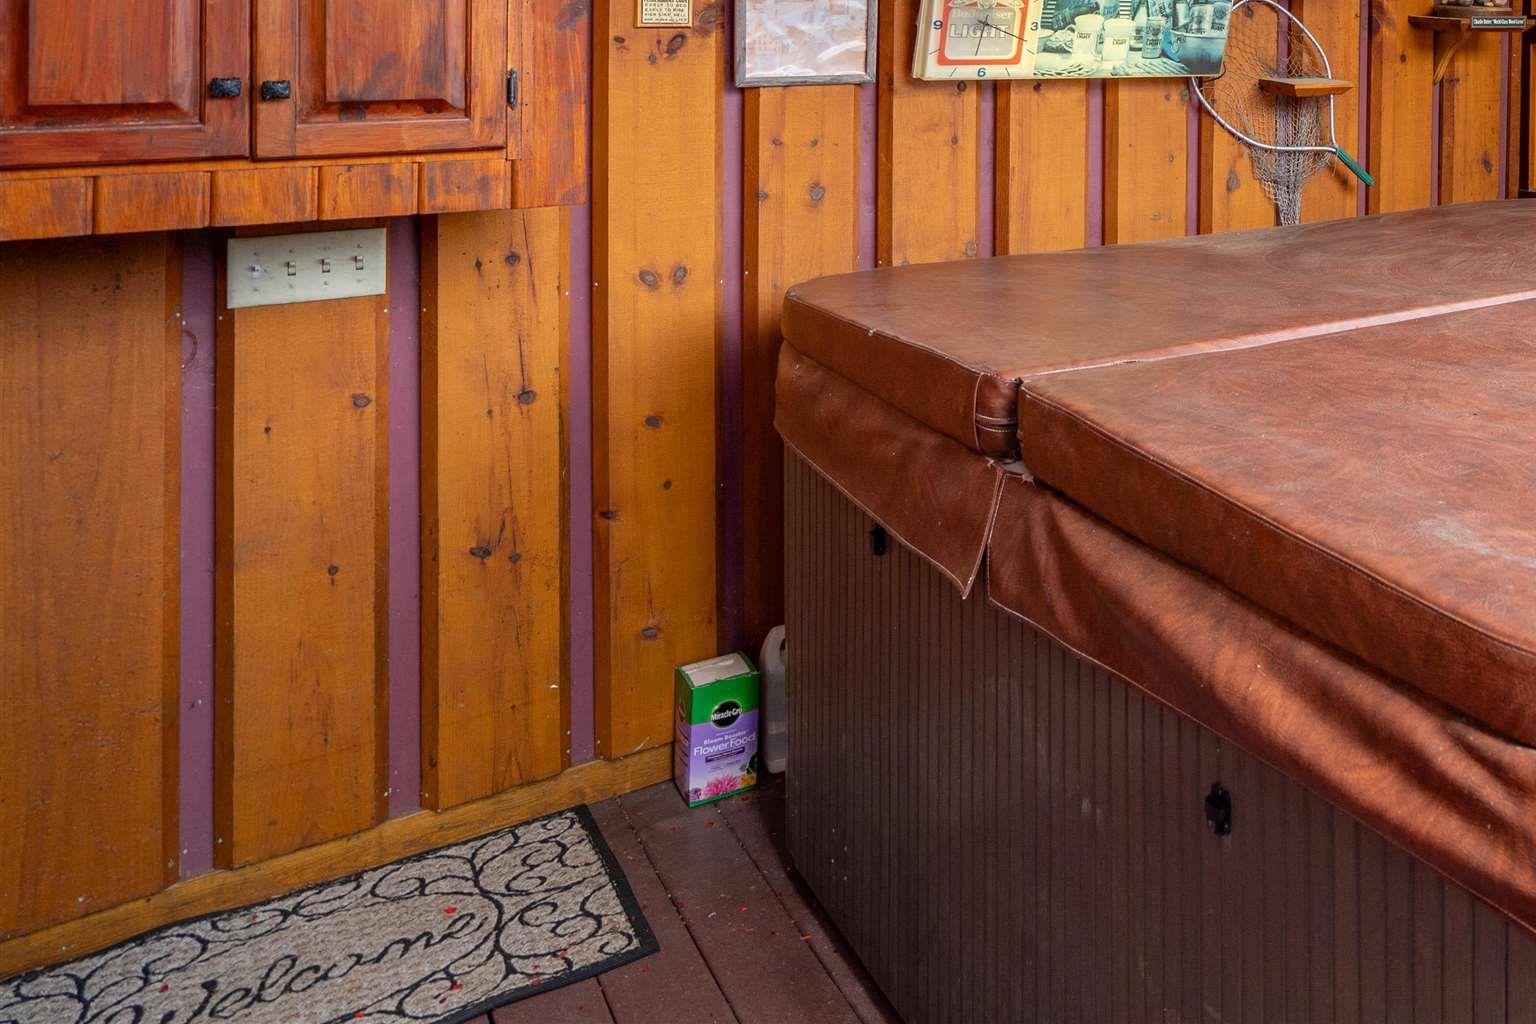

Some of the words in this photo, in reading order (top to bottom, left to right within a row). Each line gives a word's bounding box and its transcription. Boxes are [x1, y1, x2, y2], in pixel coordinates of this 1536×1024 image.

[933, 19, 943, 29] 9
[1030, 22, 1039, 31] 3
[949, 24, 1010, 39] LIGHT
[977, 68, 986, 77] 6
[694, 742, 730, 755] Flower
[730, 732, 756, 747] Food
